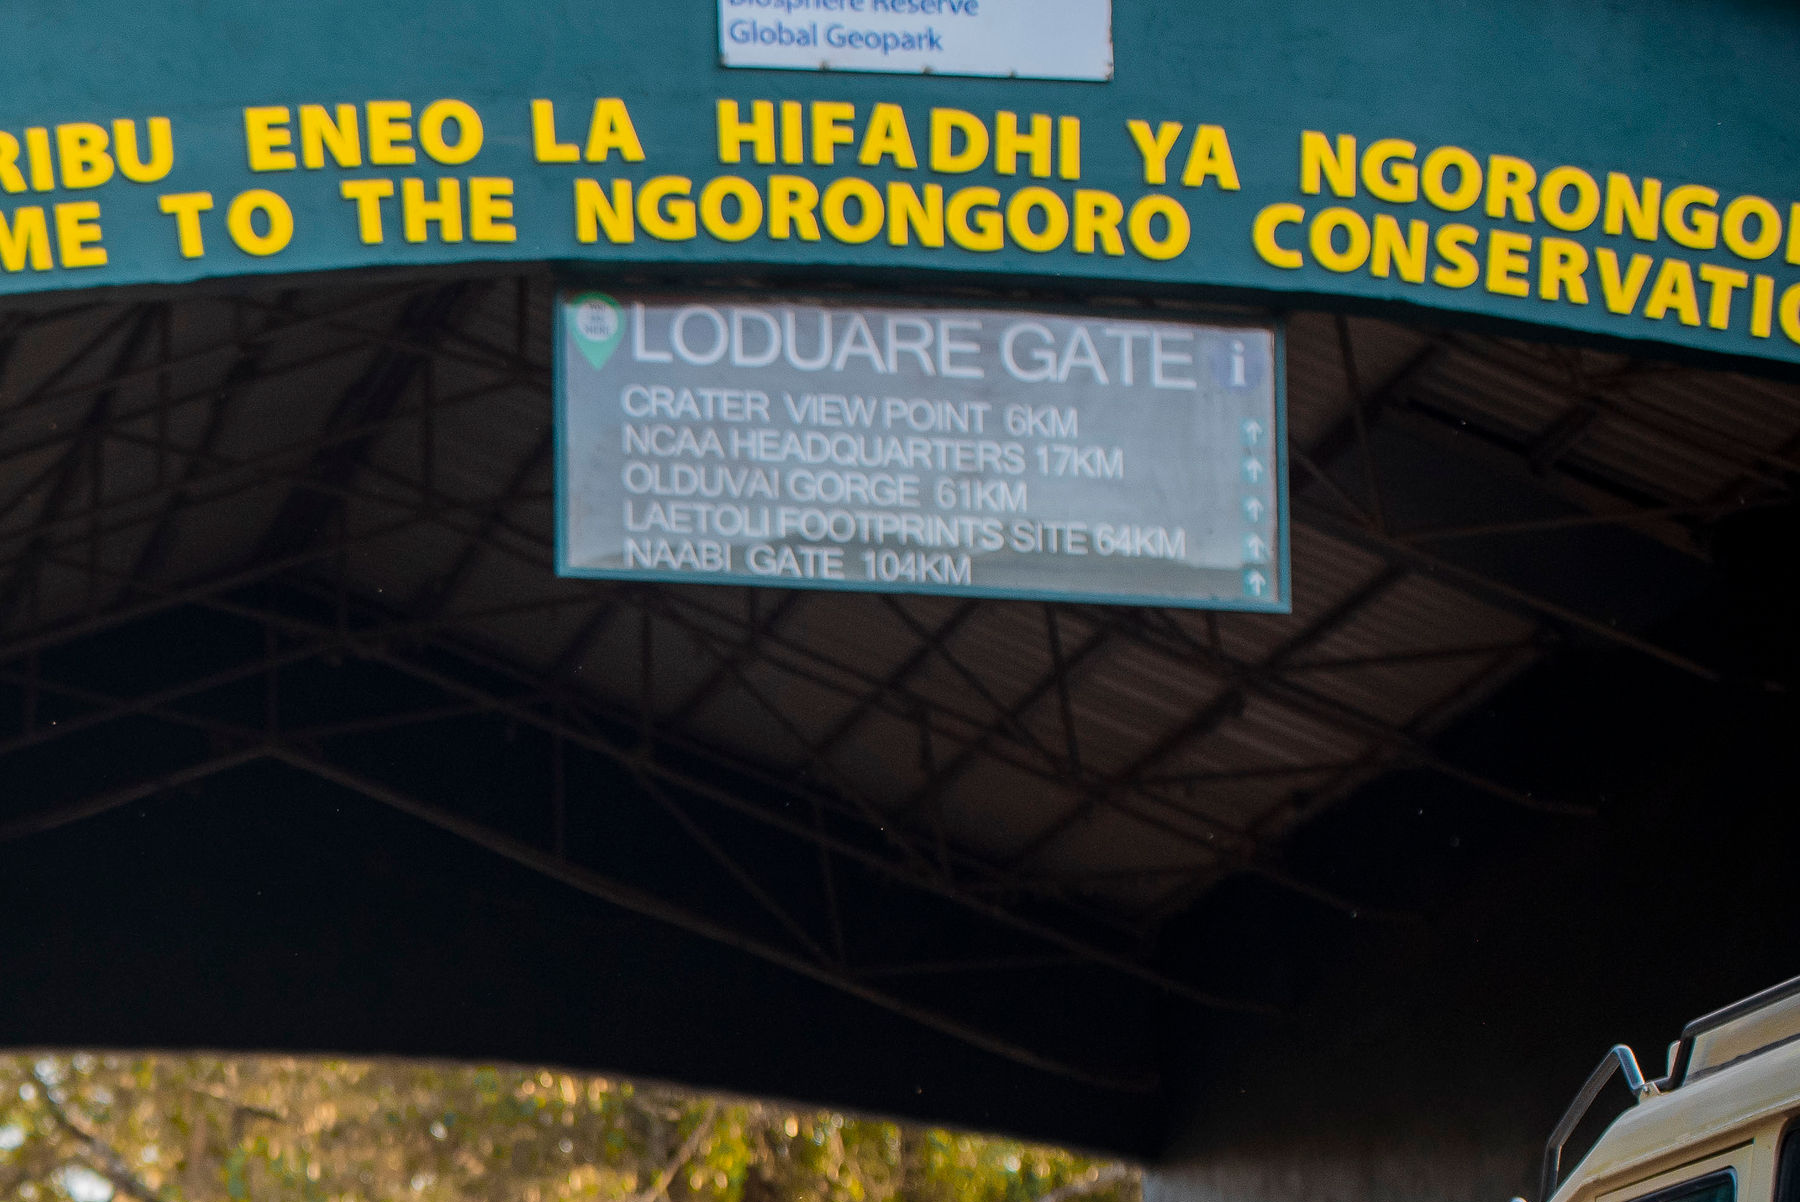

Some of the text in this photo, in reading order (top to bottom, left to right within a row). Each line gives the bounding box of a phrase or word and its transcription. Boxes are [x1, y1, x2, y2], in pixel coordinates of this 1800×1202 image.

[729, 18, 943, 55] Global Geopark
[246, 100, 483, 170] ENEO
[533, 99, 644, 162] LA
[718, 100, 1080, 179] HIFADHI
[1129, 120, 1240, 189] YA
[1302, 131, 1800, 264] NGORONGO
[160, 190, 293, 257] TO
[342, 177, 516, 243] THE
[576, 175, 1189, 259] NGORONGORO
[632, 302, 1197, 390] LODUARE GATE
[621, 383, 1079, 439] CRATER VIEW POINT 6KM
[622, 422, 1124, 480] NCAA HEADQUARTERS 17KM
[622, 461, 1028, 513] OLDUVAI GORGE 61KM
[623, 500, 1186, 559] LAETOLI FOOTPRINTS SITE 64KM
[623, 537, 972, 586] NAABI GATE 104KM
